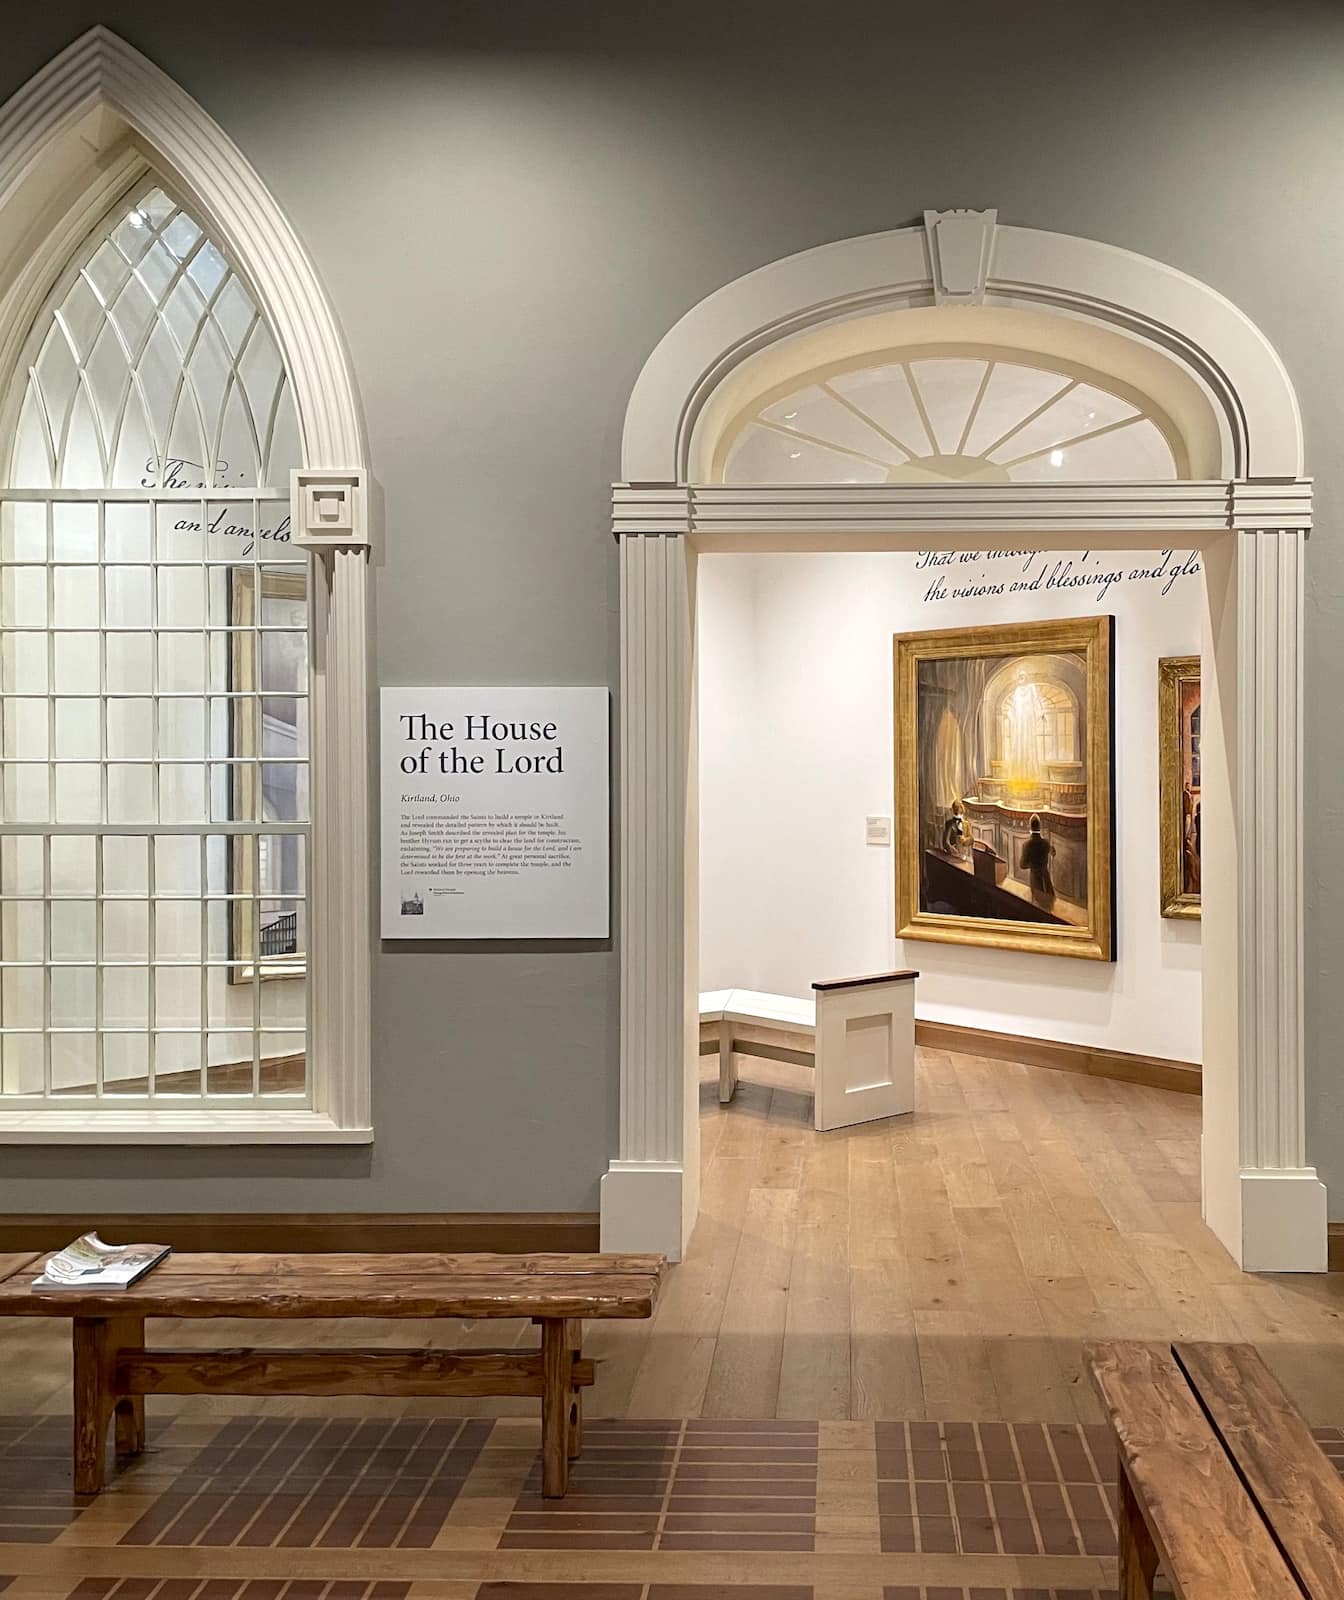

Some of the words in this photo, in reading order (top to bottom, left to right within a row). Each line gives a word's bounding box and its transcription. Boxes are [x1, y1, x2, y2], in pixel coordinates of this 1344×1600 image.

[174, 508, 227, 534] and
[960, 551, 981, 563] we
[924, 575, 948, 602] the
[952, 573, 1005, 598] visions
[1009, 563, 1047, 591] and
[1046, 560, 1123, 602] blessings
[1128, 551, 1171, 579] and
[400, 713, 454, 741] The
[464, 715, 557, 741] House
[400, 746, 432, 774] of
[438, 747, 484, 774] the
[496, 746, 564, 774] Lord
[401, 794, 438, 804] Kirtland,
[440, 794, 460, 803] Ohio
